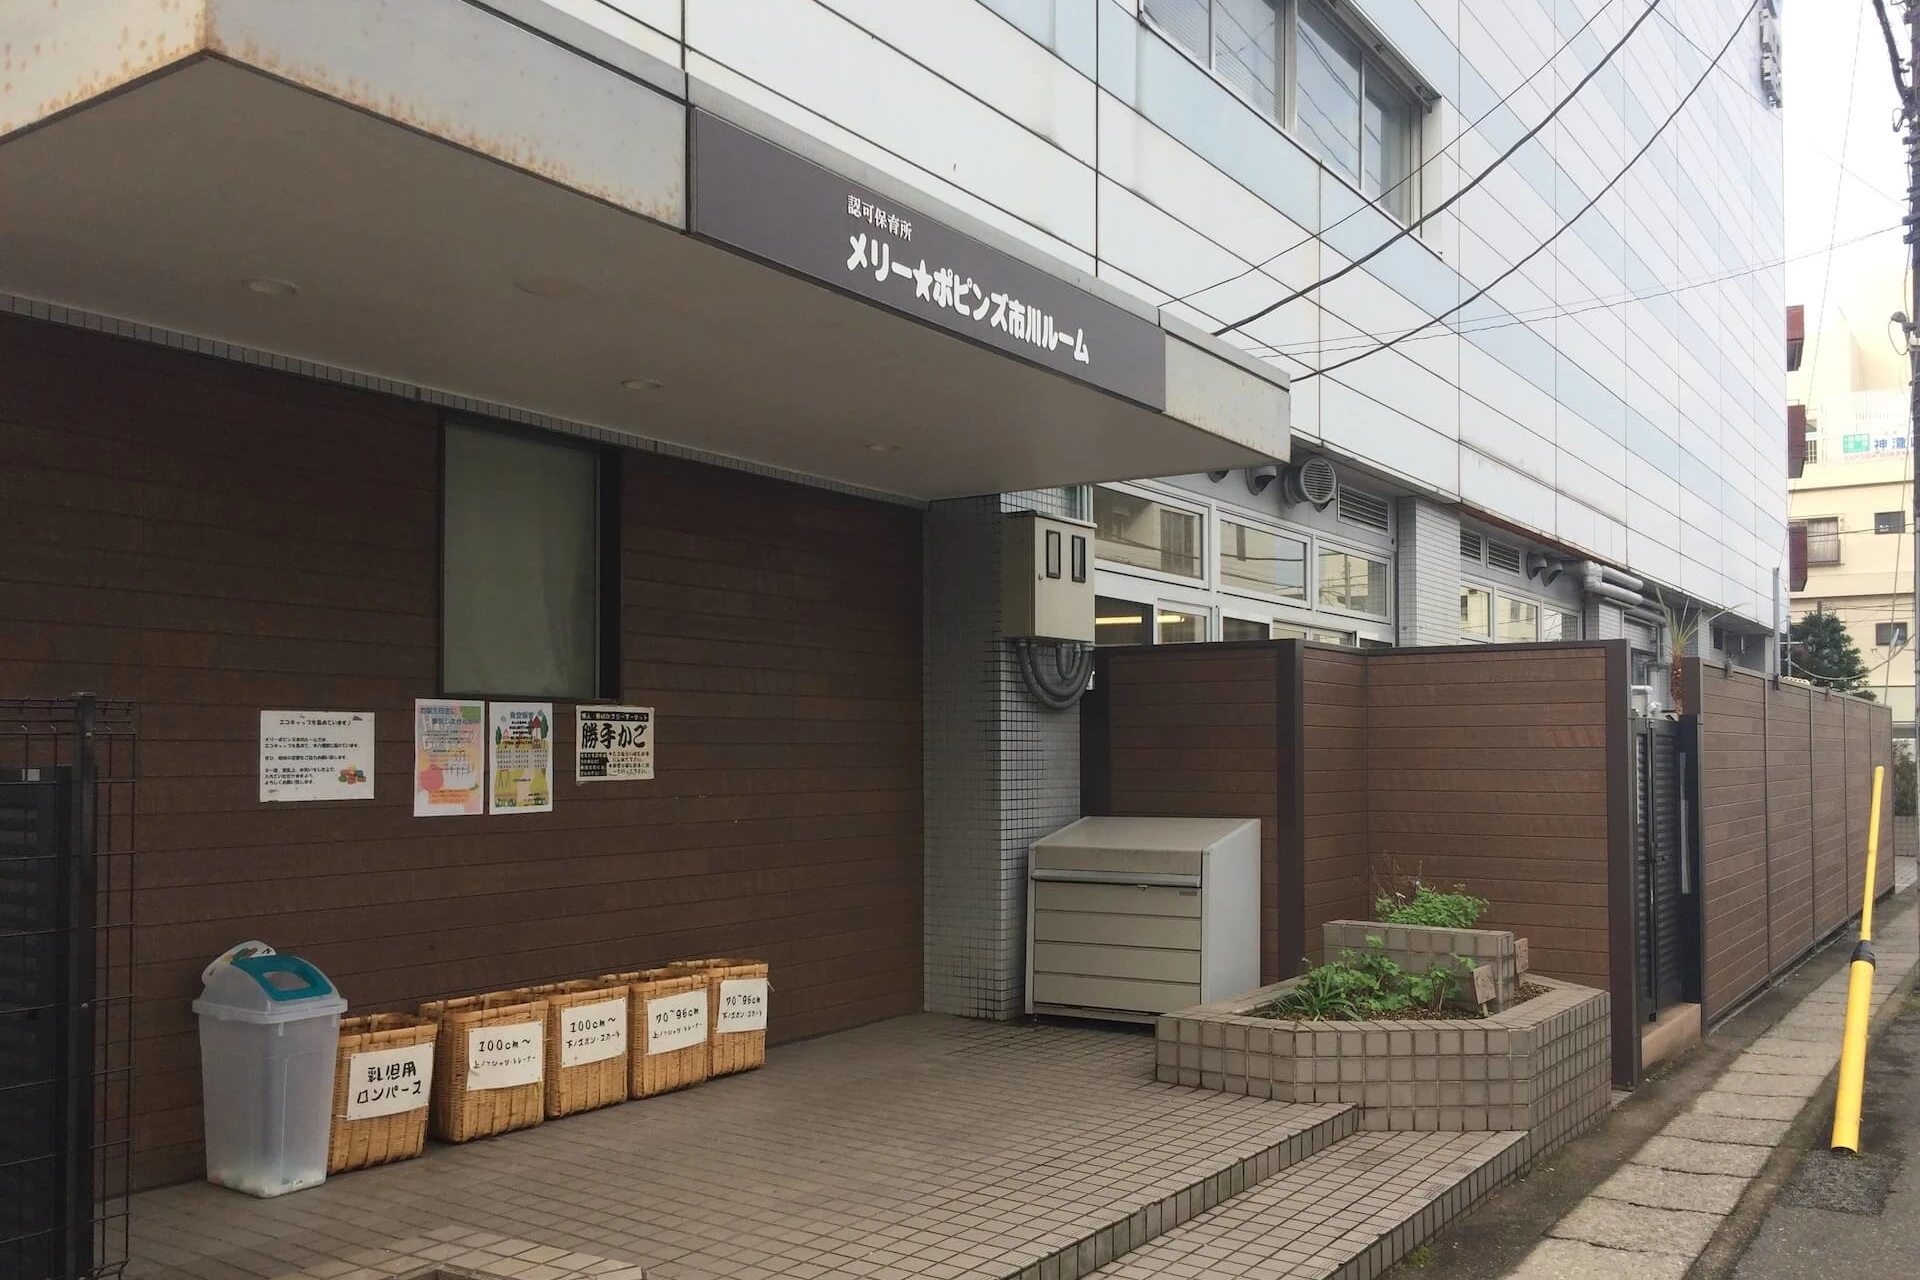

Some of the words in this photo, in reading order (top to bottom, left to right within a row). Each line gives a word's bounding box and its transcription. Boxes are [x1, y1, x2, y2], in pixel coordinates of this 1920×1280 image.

[846, 194, 913, 242] 認可保育所
[581, 722, 648, 750] 勝手かご
[368, 1061, 417, 1083] 乳児用
[357, 1080, 422, 1105] ロンパース
